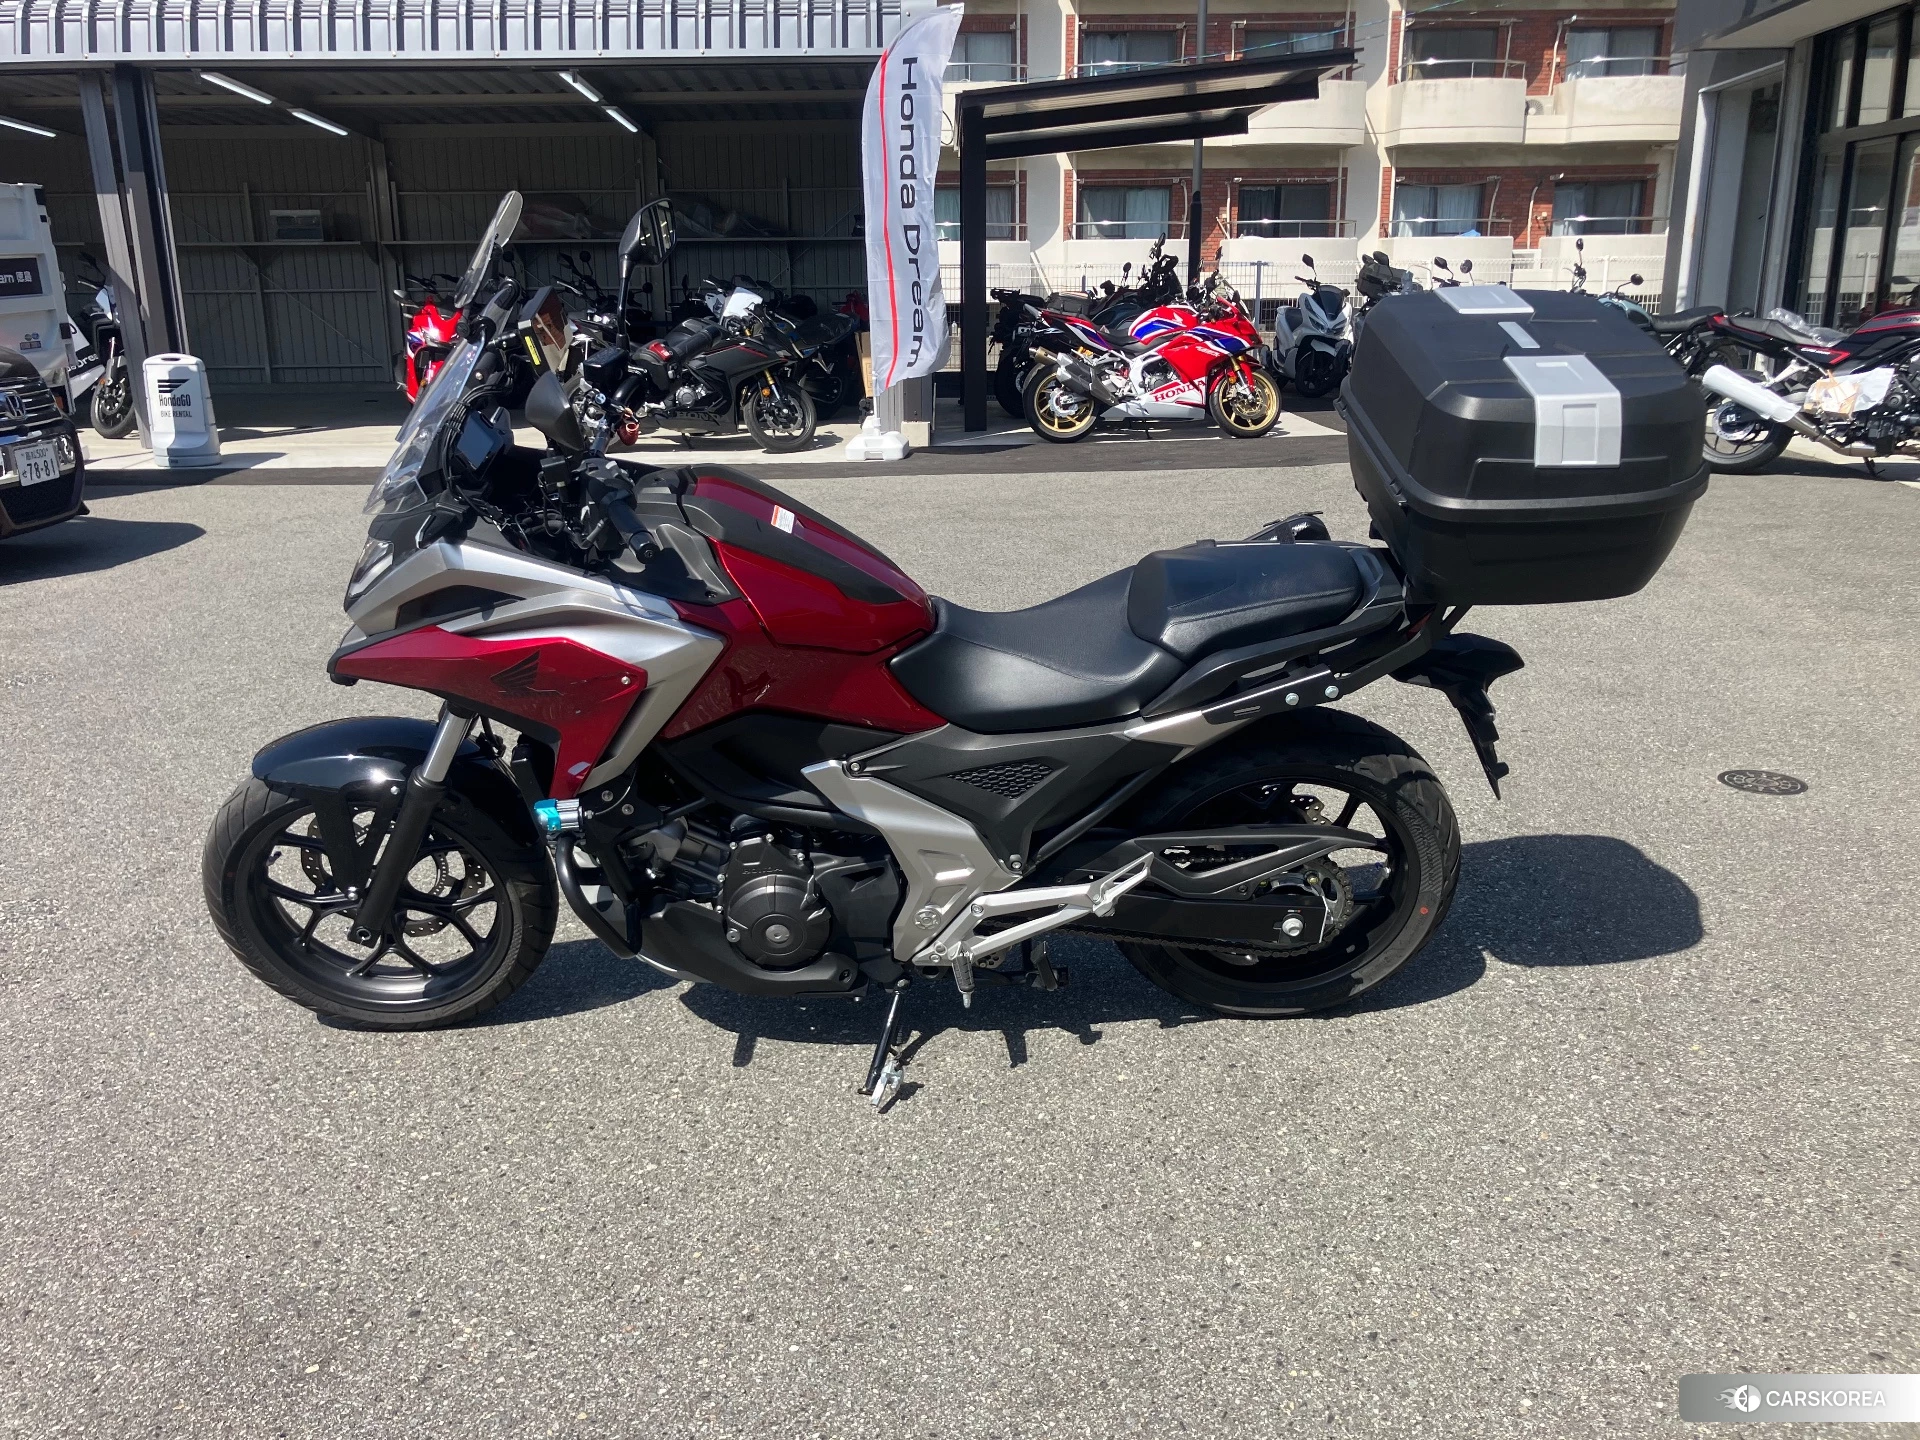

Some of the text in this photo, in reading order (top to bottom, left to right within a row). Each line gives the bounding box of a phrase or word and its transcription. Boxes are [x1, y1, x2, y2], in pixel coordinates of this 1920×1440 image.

[900, 56, 925, 368] Honda Dream
[158, 393, 192, 407] HondaGO
[160, 410, 193, 418] BIKE RENTAL
[26, 458, 56, 481] 78-81
